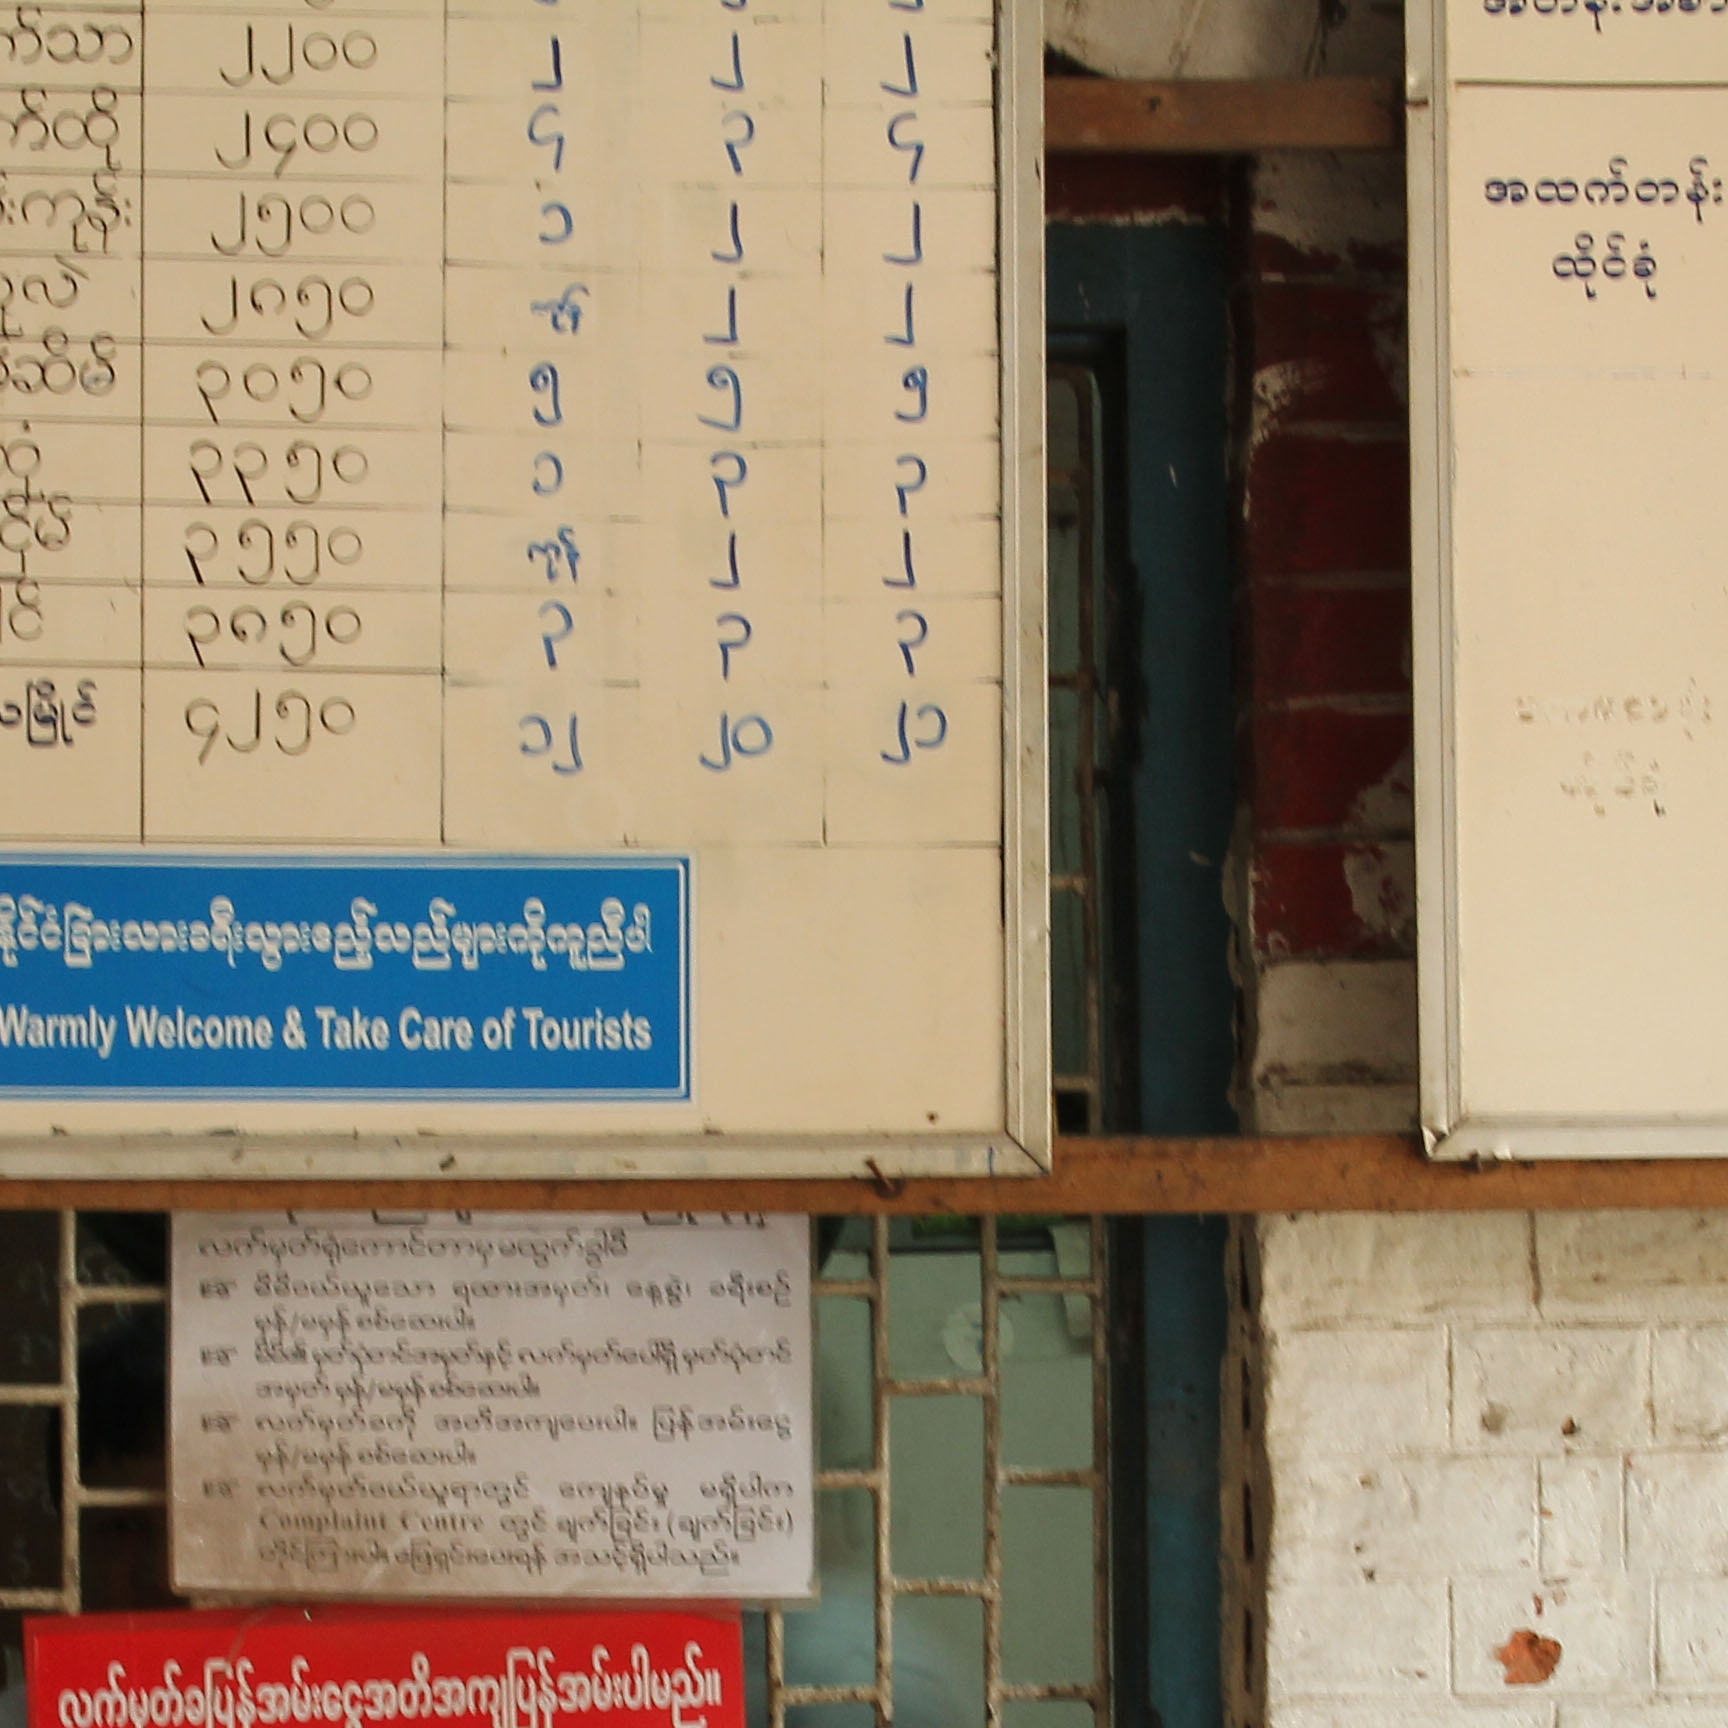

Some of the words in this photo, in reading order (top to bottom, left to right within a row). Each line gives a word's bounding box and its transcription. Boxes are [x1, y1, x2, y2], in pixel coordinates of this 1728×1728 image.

[126, 1005, 273, 1050] Welcome
[282, 1006, 307, 1049] &
[316, 1006, 389, 1050] Take
[398, 1008, 473, 1051] Care
[482, 1006, 516, 1050] of
[522, 1006, 653, 1051] Tourists
